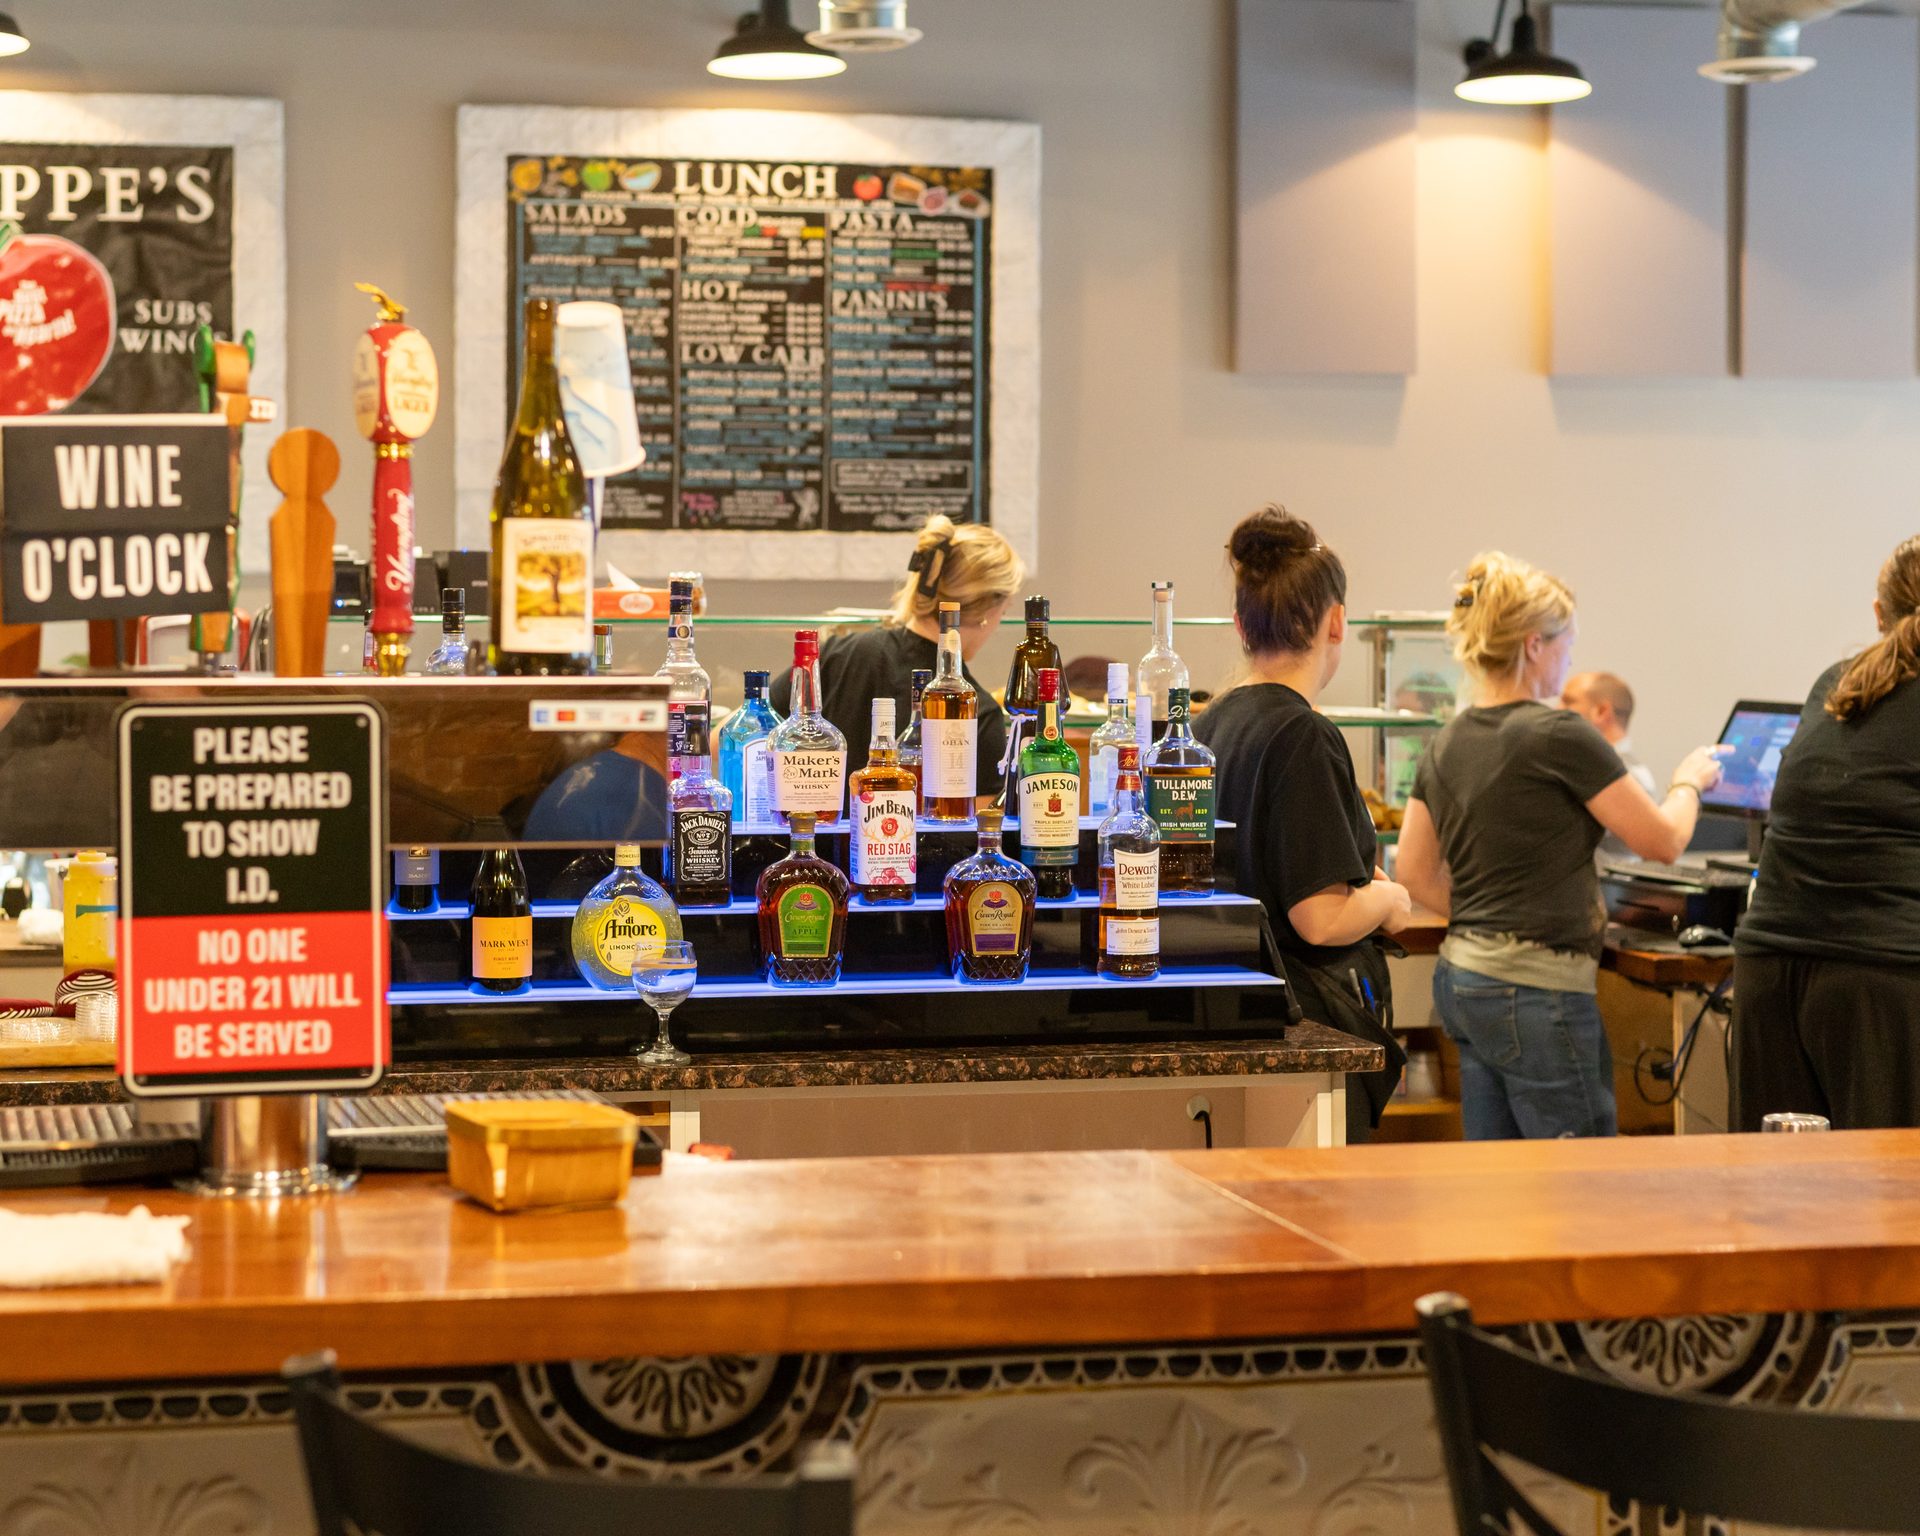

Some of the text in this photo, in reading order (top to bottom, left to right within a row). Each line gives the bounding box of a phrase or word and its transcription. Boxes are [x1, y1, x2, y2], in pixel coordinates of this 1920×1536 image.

[673, 162, 838, 199] LUNCH
[0, 165, 215, 223] PPE'S
[525, 203, 627, 225] SALADS
[678, 206, 759, 228] COLD
[830, 211, 914, 231] PASTA
[682, 280, 743, 300] HOT
[135, 299, 213, 325] SUBS
[681, 343, 825, 366] LOW CARB
[54, 444, 182, 510] WINE
[22, 532, 213, 603] O'CLOCK
[193, 726, 309, 764] PLEASE
[783, 755, 841, 766] Maker's
[799, 768, 840, 778] Mark
[151, 771, 352, 812] BE PREPARED
[1025, 778, 1079, 795] JAMESON
[1154, 779, 1213, 790] TULLAMORE
[1172, 790, 1198, 801] D.E.W.
[864, 799, 914, 823] JIM BEAM
[680, 815, 727, 833] JACK DANIEL'S
[183, 818, 320, 858] TO SHOW
[867, 842, 911, 856] RED STAG
[688, 847, 718, 855] Tennessee
[1119, 863, 1158, 876] Dewar's
[226, 867, 279, 904] I.D.
[625, 916, 634, 925] di
[975, 909, 1017, 921] Crown Royal
[603, 918, 657, 941] Amore
[198, 927, 308, 965] NO ONE
[480, 938, 529, 948] MARK WEST
[144, 972, 361, 1013] UNDER 21 WILL
[174, 1019, 333, 1059] BE SERVED
